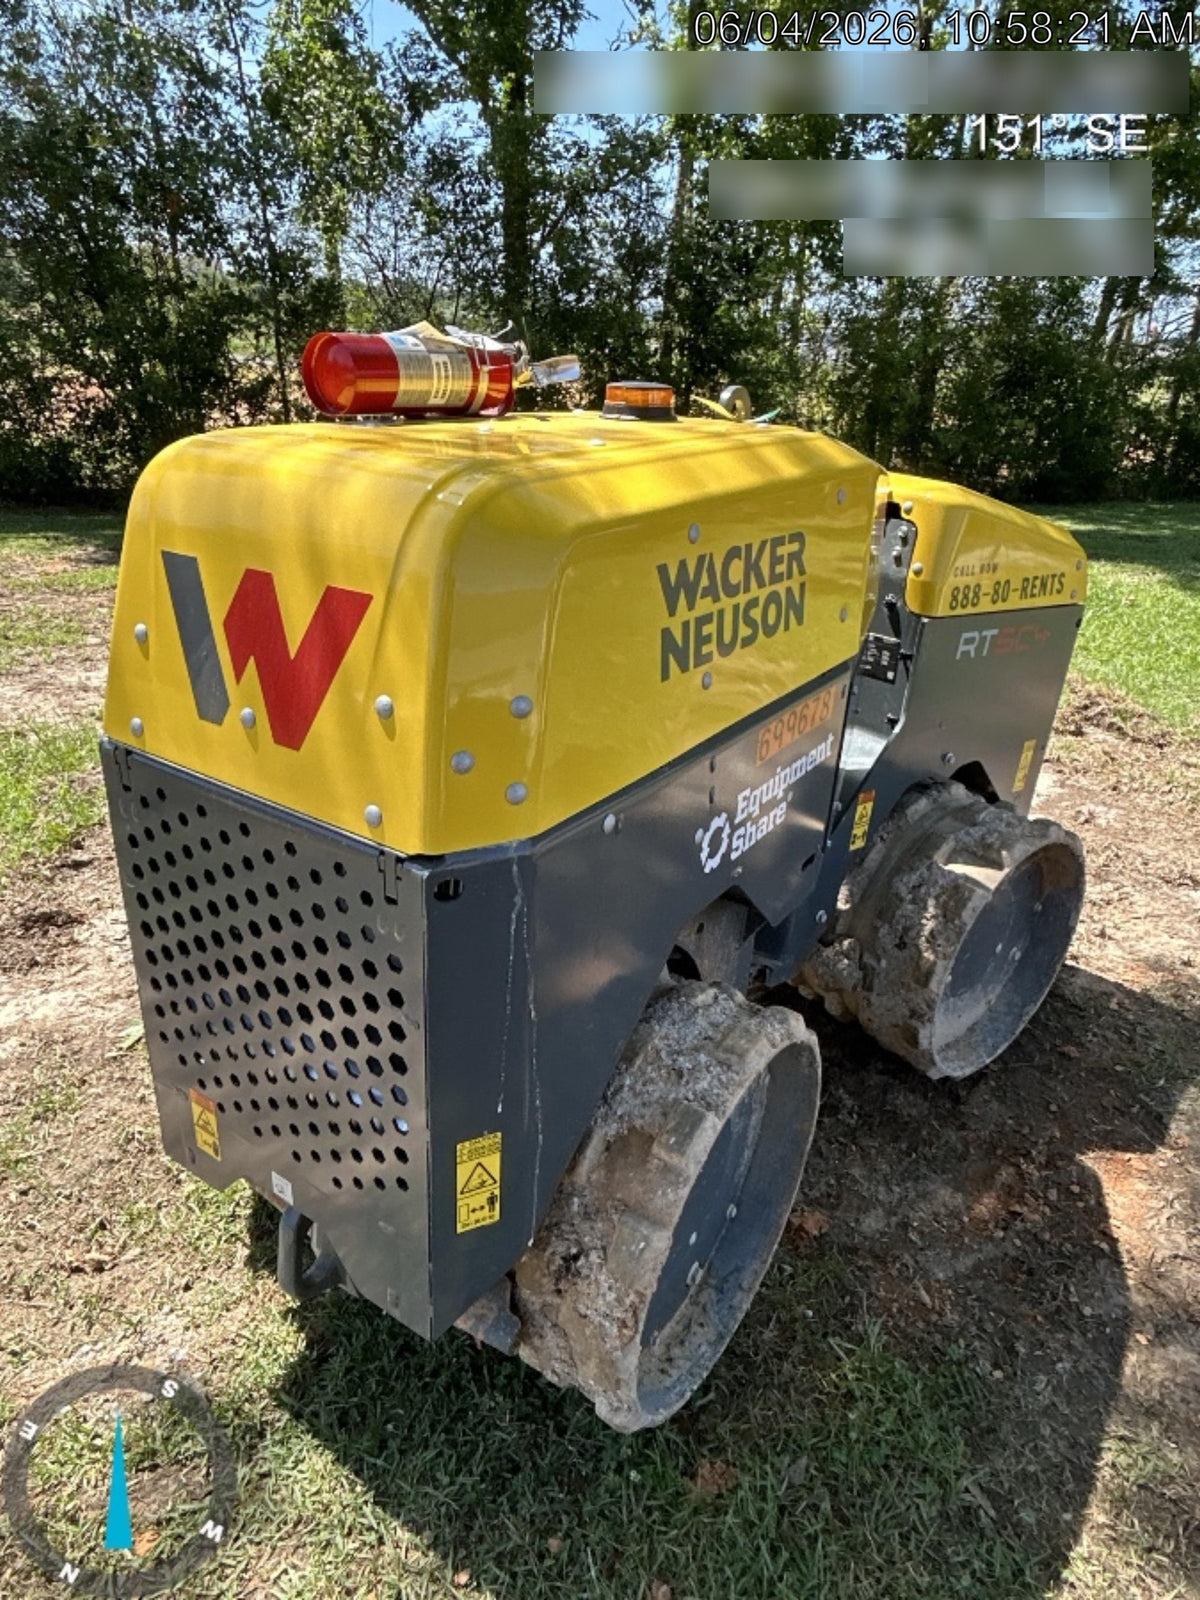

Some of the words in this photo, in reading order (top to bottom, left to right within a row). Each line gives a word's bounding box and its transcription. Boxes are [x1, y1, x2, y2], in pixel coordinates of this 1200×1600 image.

[656, 531, 807, 618] WACKER
[949, 572, 1066, 611] 888-80-RENTS
[161, 549, 374, 752] W
[660, 581, 807, 683] NEUSON
[759, 690, 831, 762] 699678
[734, 732, 834, 824] Equipment
[730, 801, 787, 861] Share
